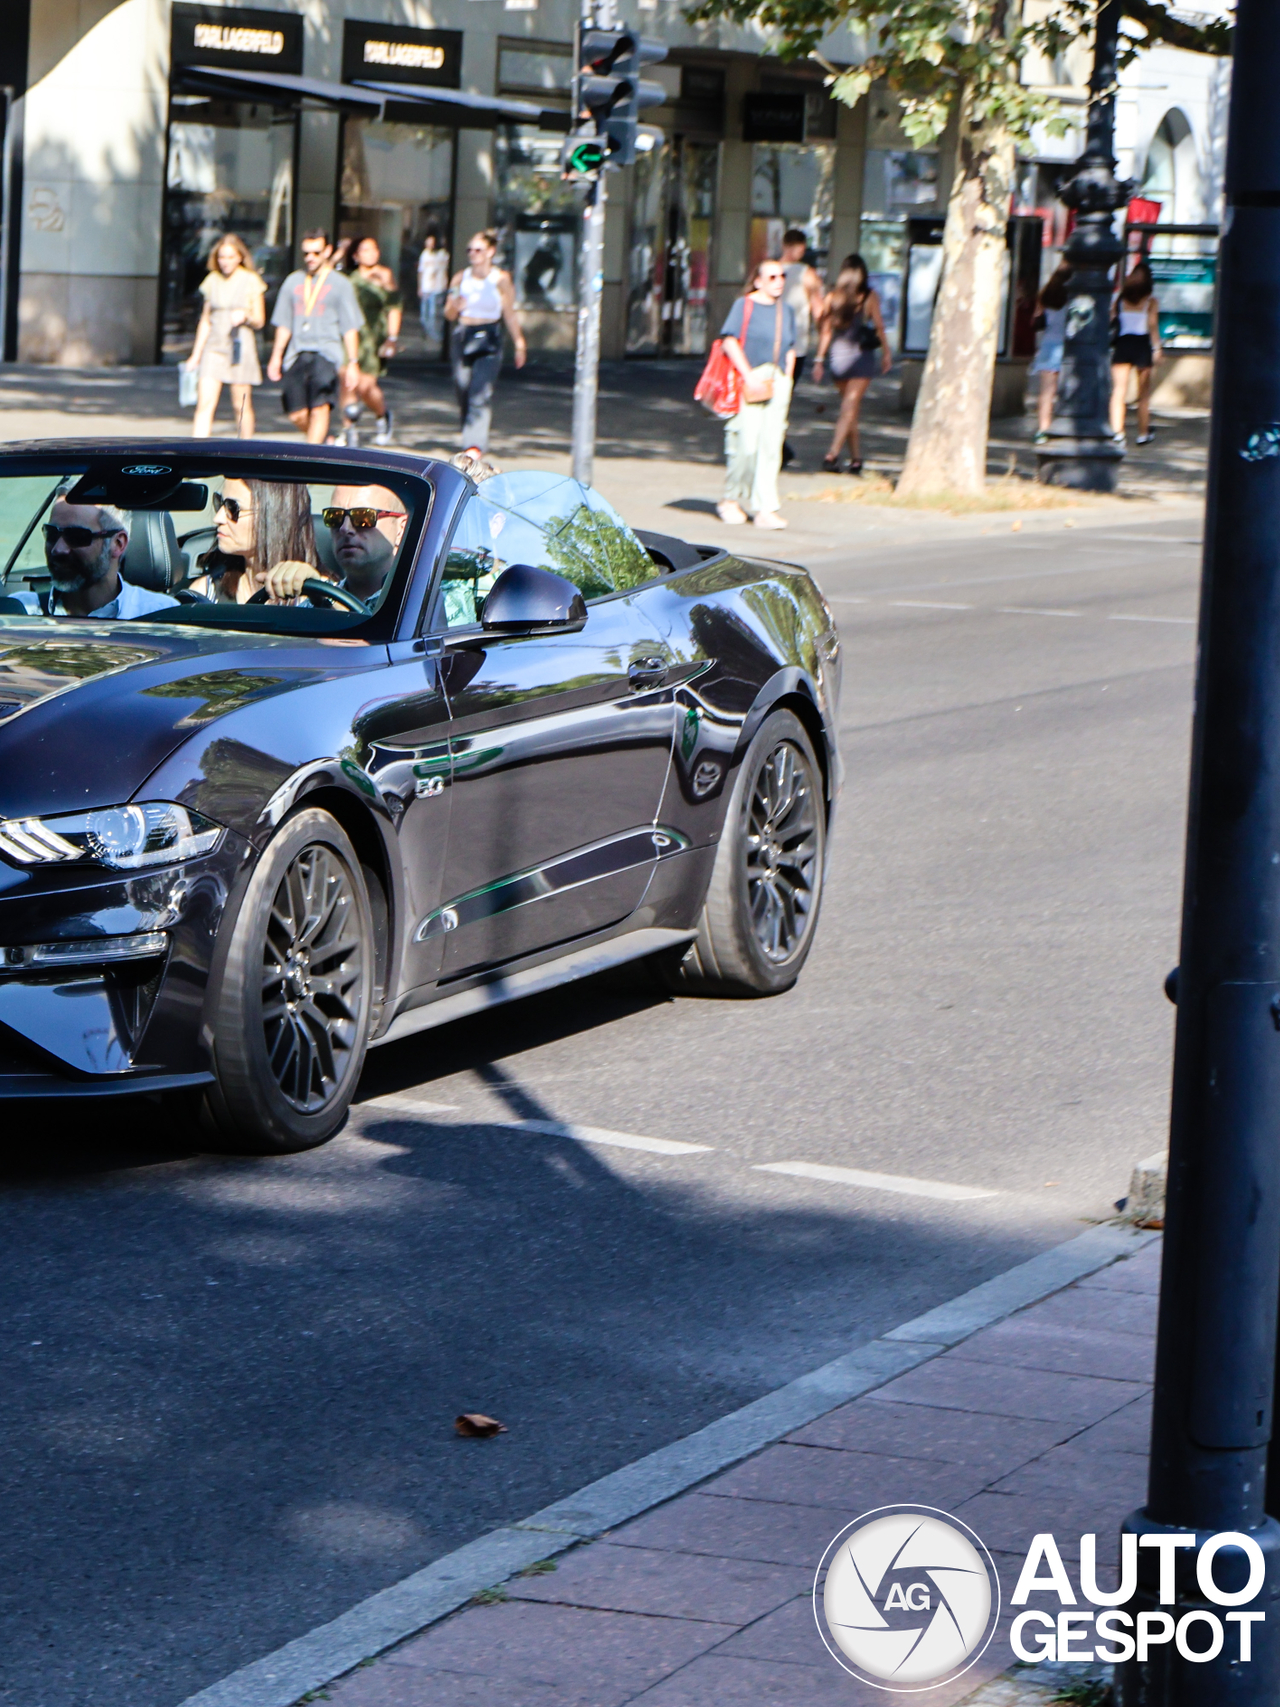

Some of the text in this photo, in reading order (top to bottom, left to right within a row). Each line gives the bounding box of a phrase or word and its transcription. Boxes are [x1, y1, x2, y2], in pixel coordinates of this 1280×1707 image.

[194, 23, 284, 55] KARL LAGERFELD
[363, 40, 445, 69] KARL LAGERFELD
[129, 465, 163, 474] Ford
[415, 775, 445, 800] 5.0
